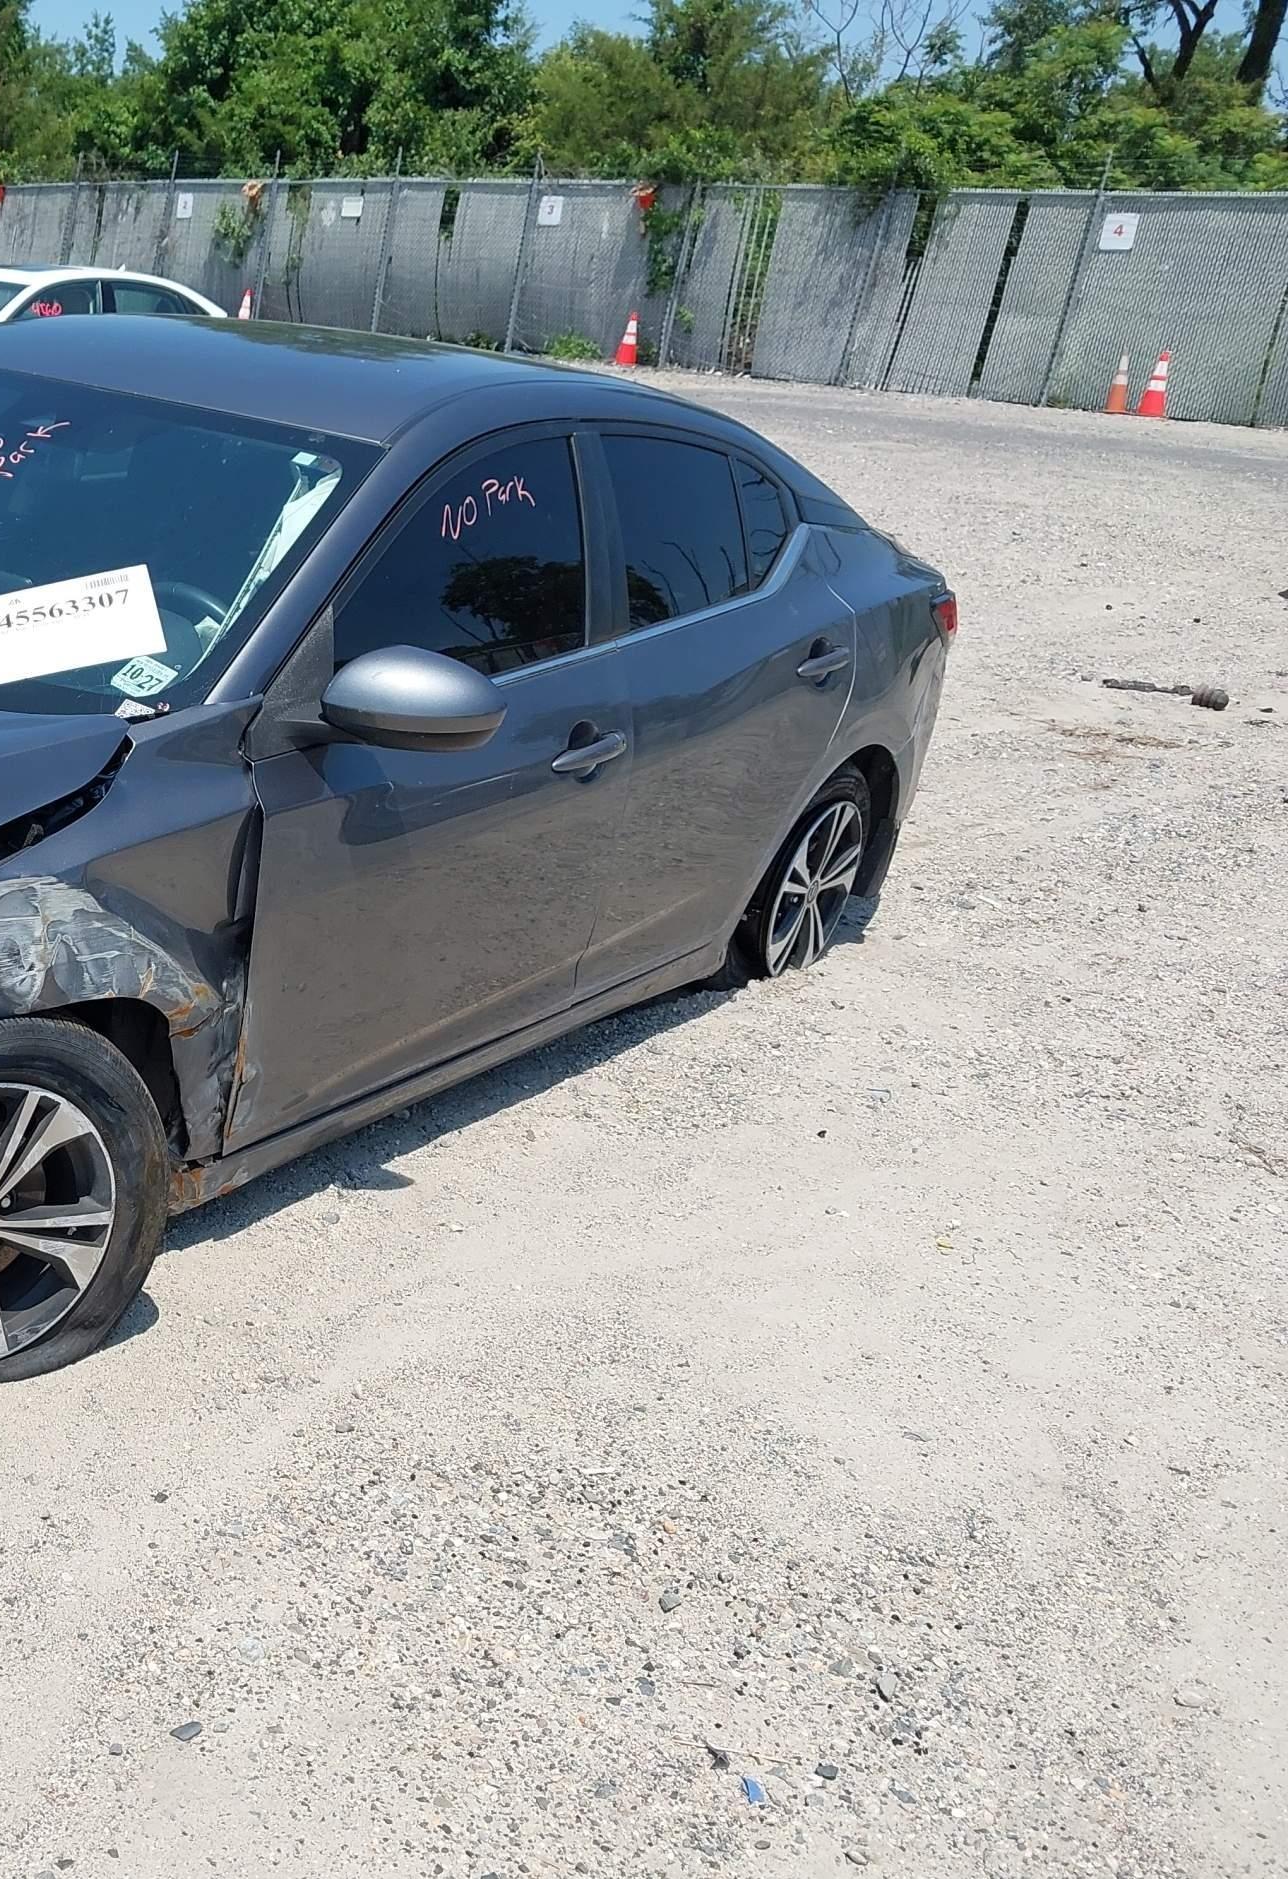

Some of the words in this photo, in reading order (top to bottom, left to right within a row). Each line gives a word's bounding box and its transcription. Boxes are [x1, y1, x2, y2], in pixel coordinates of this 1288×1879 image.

[1113, 223, 1124, 236] 4
[441, 496, 478, 540] NO
[481, 475, 536, 517] Park
